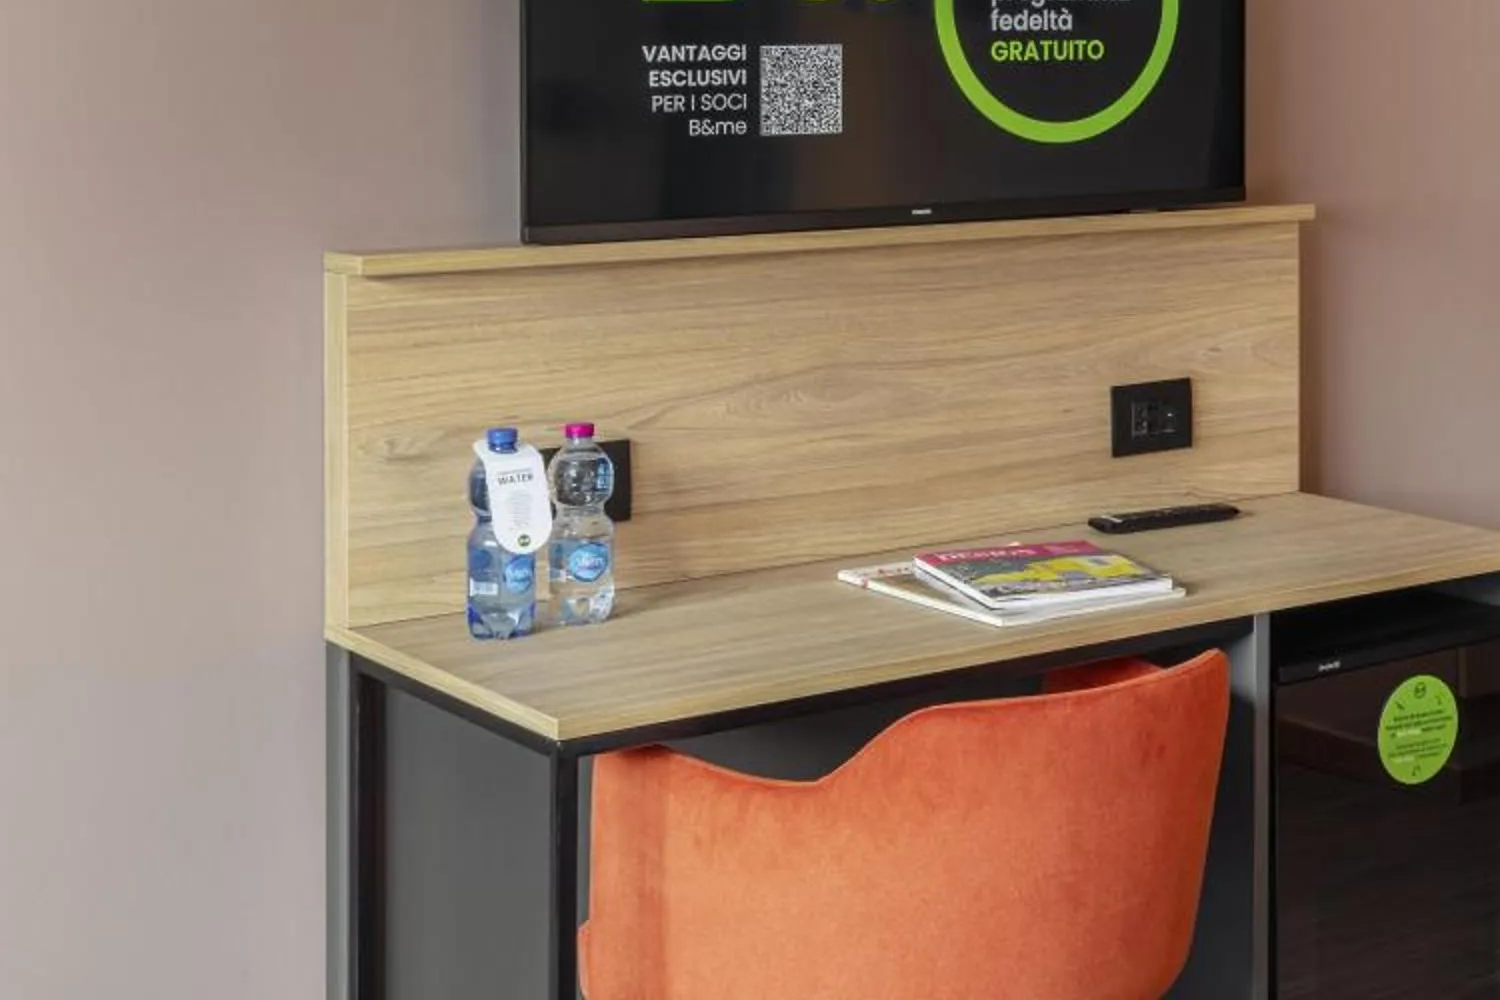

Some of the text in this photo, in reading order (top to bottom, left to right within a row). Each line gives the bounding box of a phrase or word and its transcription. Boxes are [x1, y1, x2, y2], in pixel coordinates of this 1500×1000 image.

[991, 8, 1073, 31] fedeltà
[642, 44, 747, 62] VANTAGGI
[991, 39, 1105, 61] GRATUITO
[649, 69, 747, 87] ESCLUSIVI
[651, 94, 685, 112] PER
[701, 93, 747, 111] SOCI
[689, 119, 747, 136] B&me
